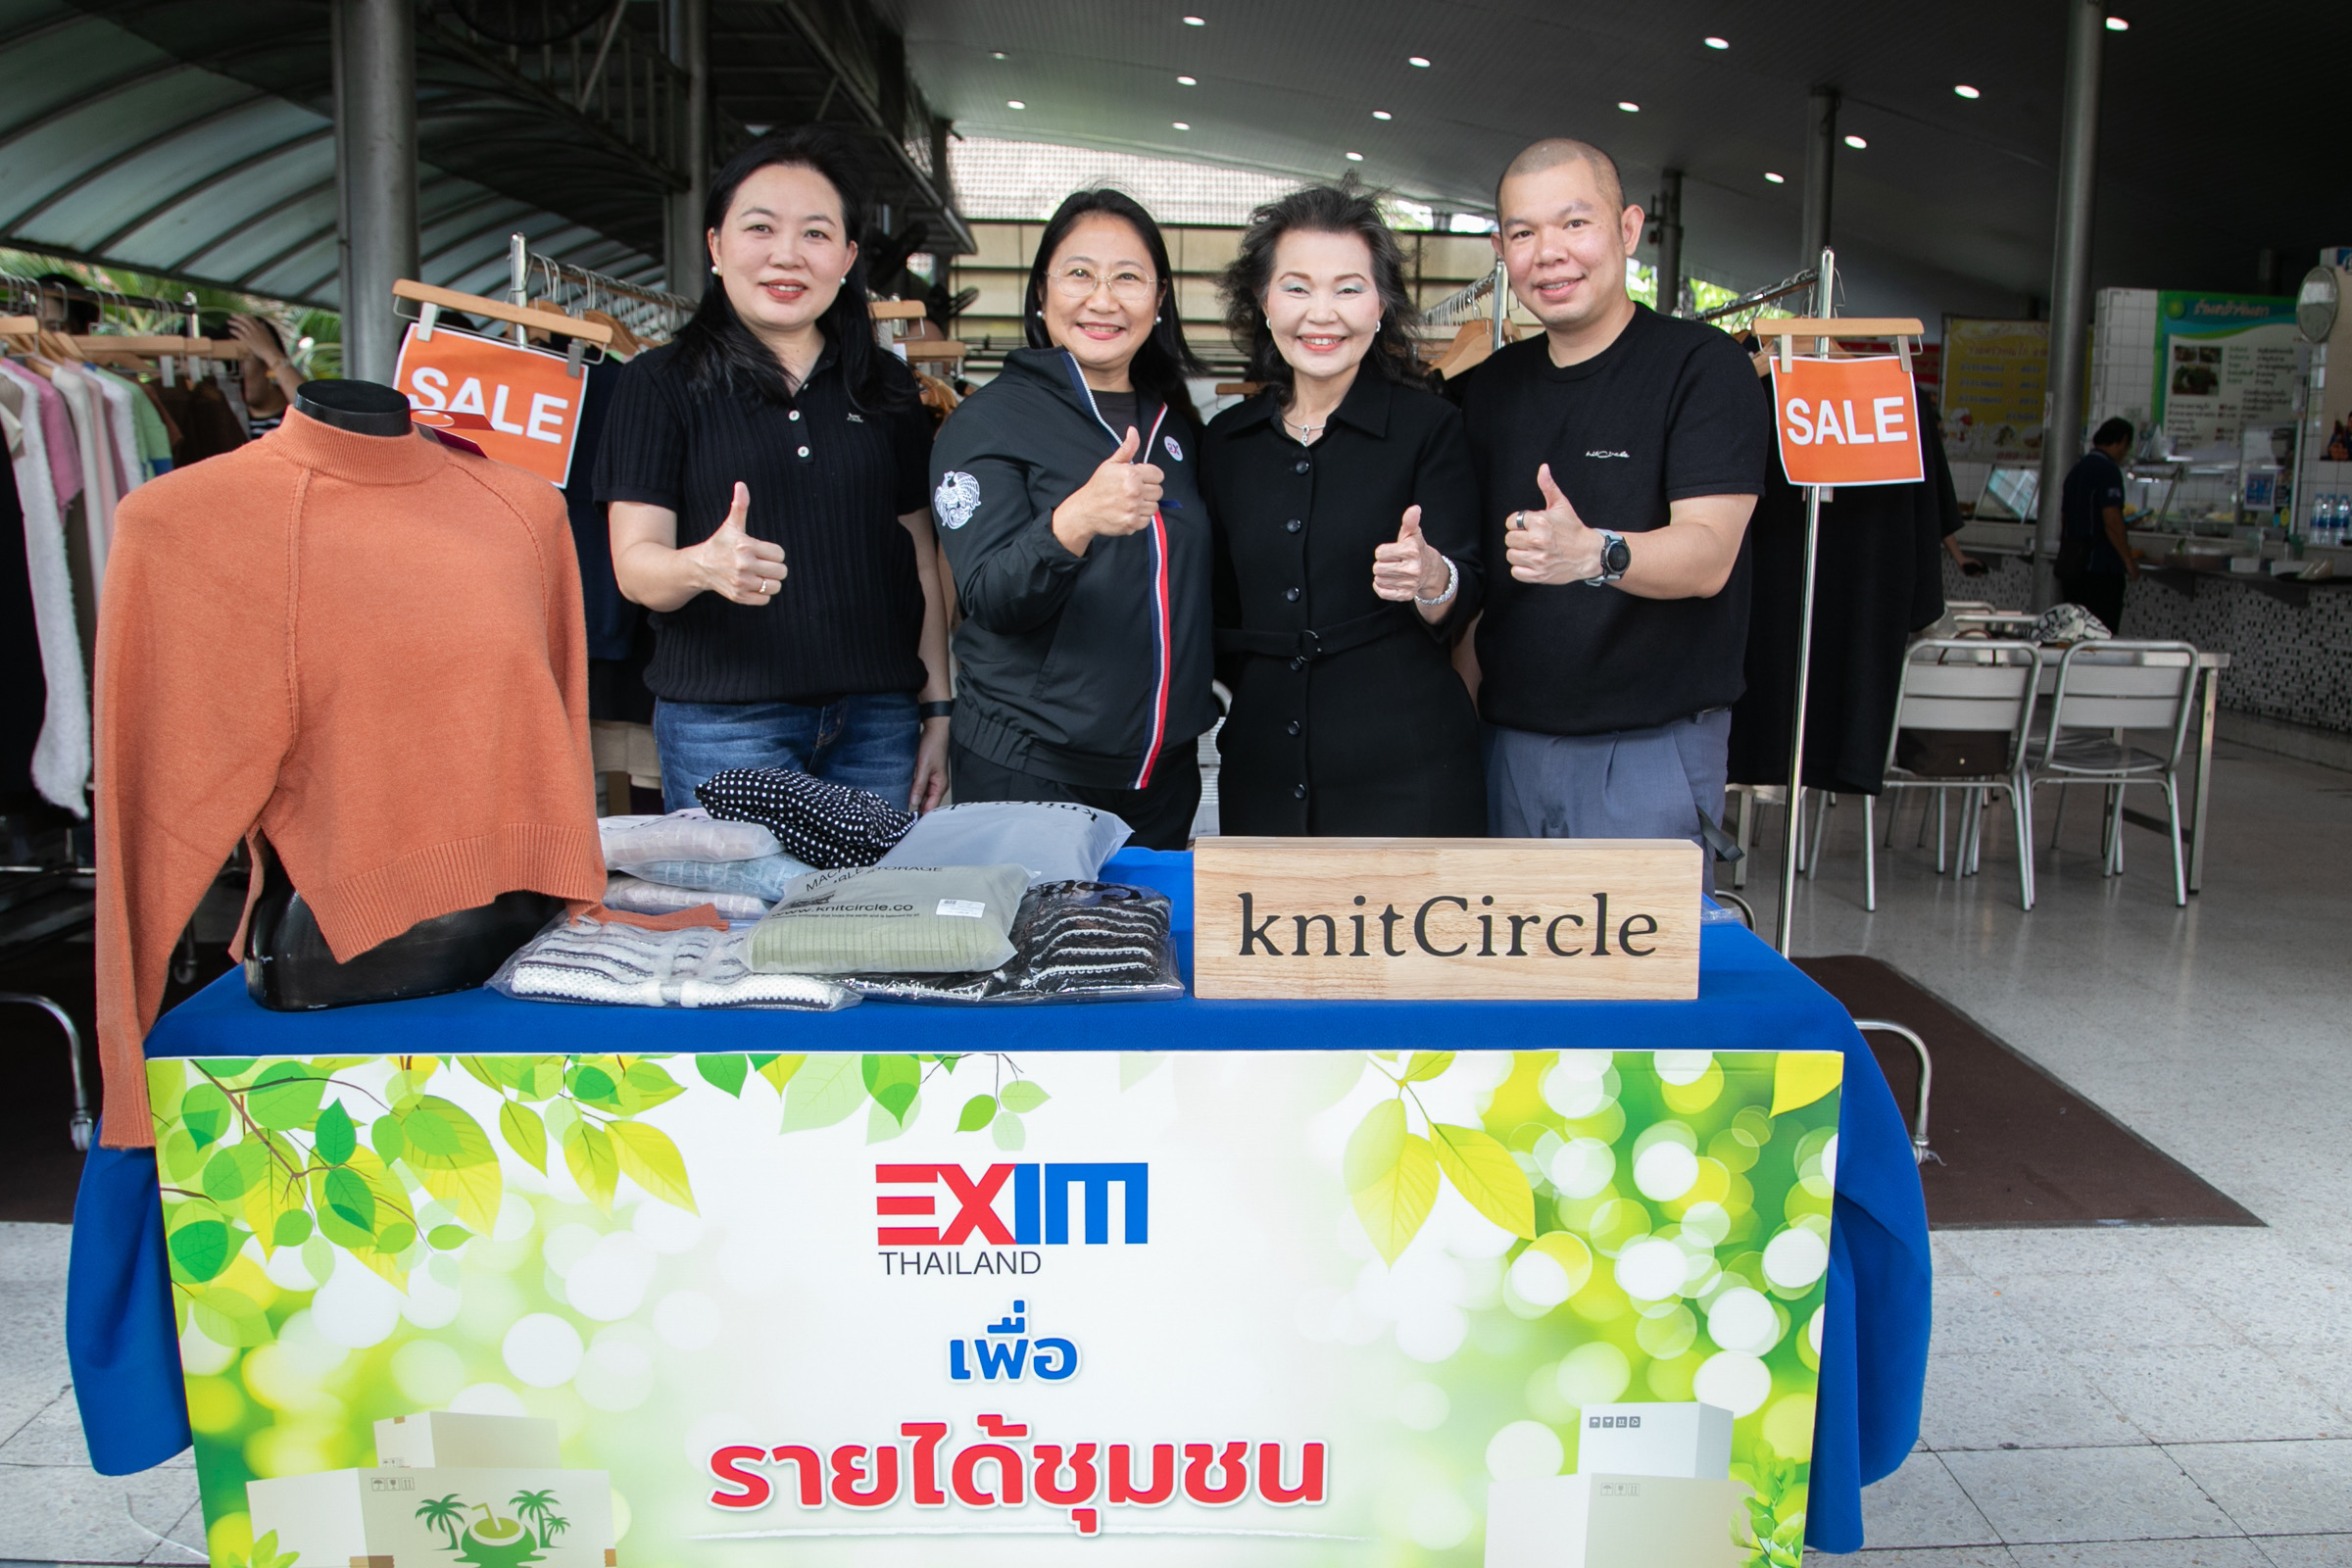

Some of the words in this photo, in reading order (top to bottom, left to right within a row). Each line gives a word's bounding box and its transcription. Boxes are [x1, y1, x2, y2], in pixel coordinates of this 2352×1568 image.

[407, 367, 568, 444] SALE
[1786, 396, 1908, 445] SALE
[771, 903, 913, 917] www.knitcircle.co
[1238, 892, 1658, 956] knitCircle
[876, 1162, 1149, 1246] EXIM
[878, 1250, 1042, 1275] THAILAND
[950, 1299, 1078, 1381] เพื่อ
[710, 1413, 1325, 1534] รายได้ชุมชน
